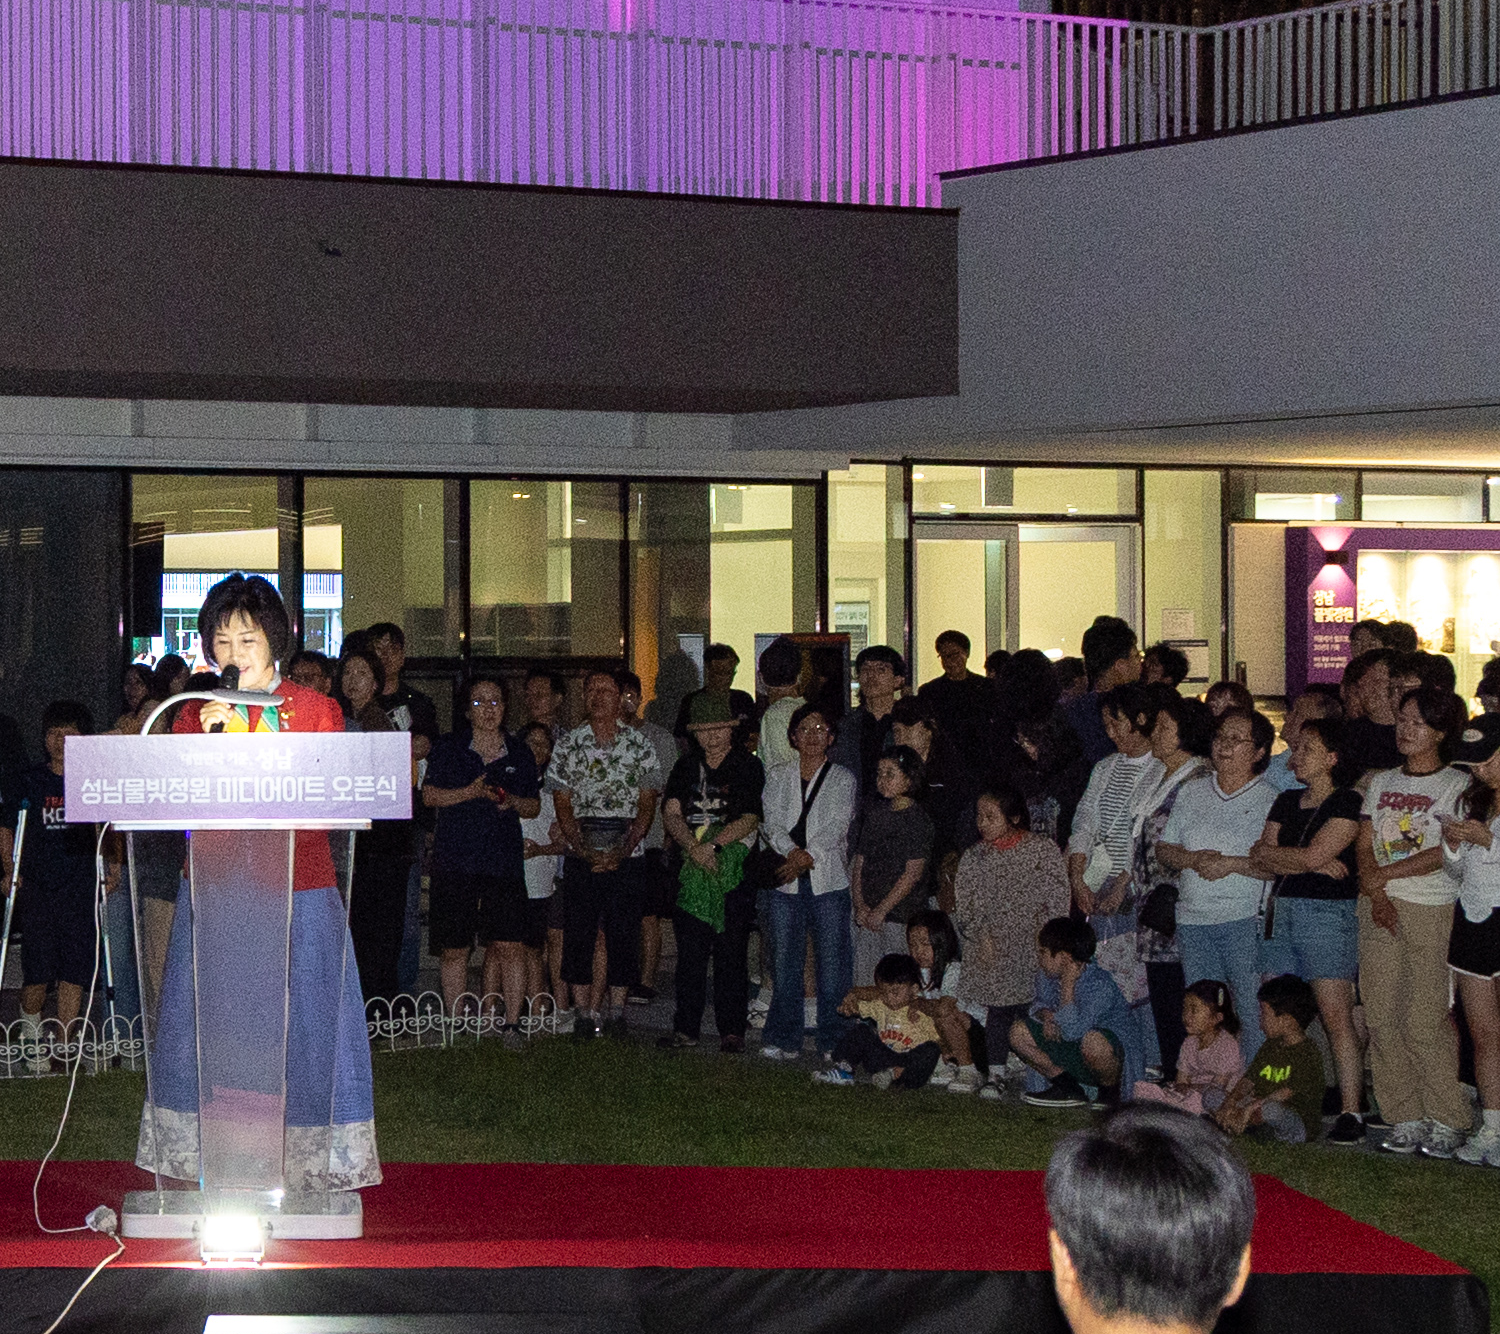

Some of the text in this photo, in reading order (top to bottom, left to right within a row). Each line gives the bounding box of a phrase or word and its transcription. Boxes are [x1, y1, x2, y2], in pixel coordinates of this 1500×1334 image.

[255, 747, 294, 770] 성남
[80, 775, 397, 805] 성남물빛정원 미디어아트 오픈식
